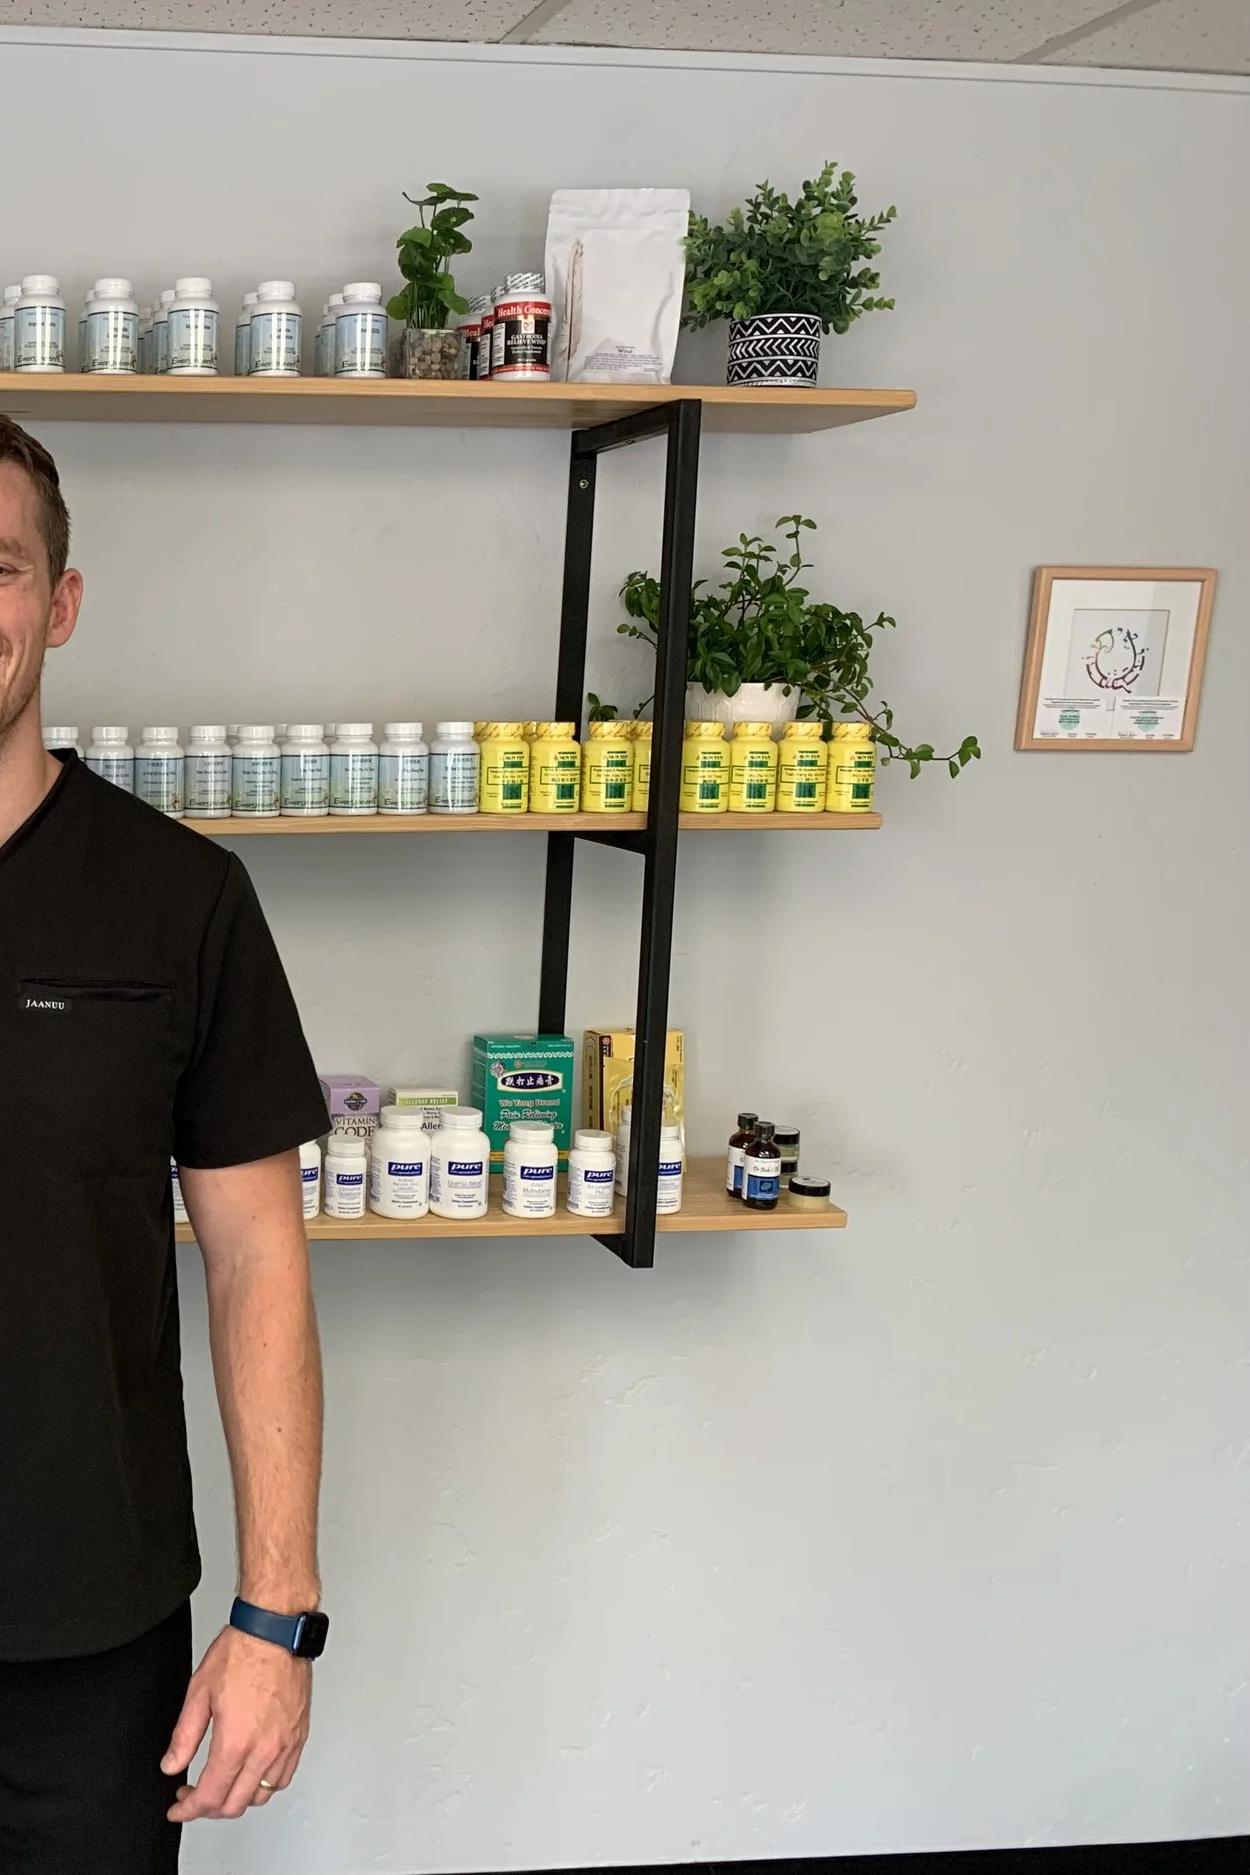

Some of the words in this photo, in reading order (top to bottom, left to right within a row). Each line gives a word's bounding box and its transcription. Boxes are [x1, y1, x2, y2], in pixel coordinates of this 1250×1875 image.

[498, 305, 523, 317] Health
[26, 999, 65, 1010] JAANUU
[500, 1109, 521, 1119] Pain
[522, 1108, 558, 1120] Relieving
[336, 1117, 377, 1125] VITAMIN
[421, 1122, 442, 1130] Aller
